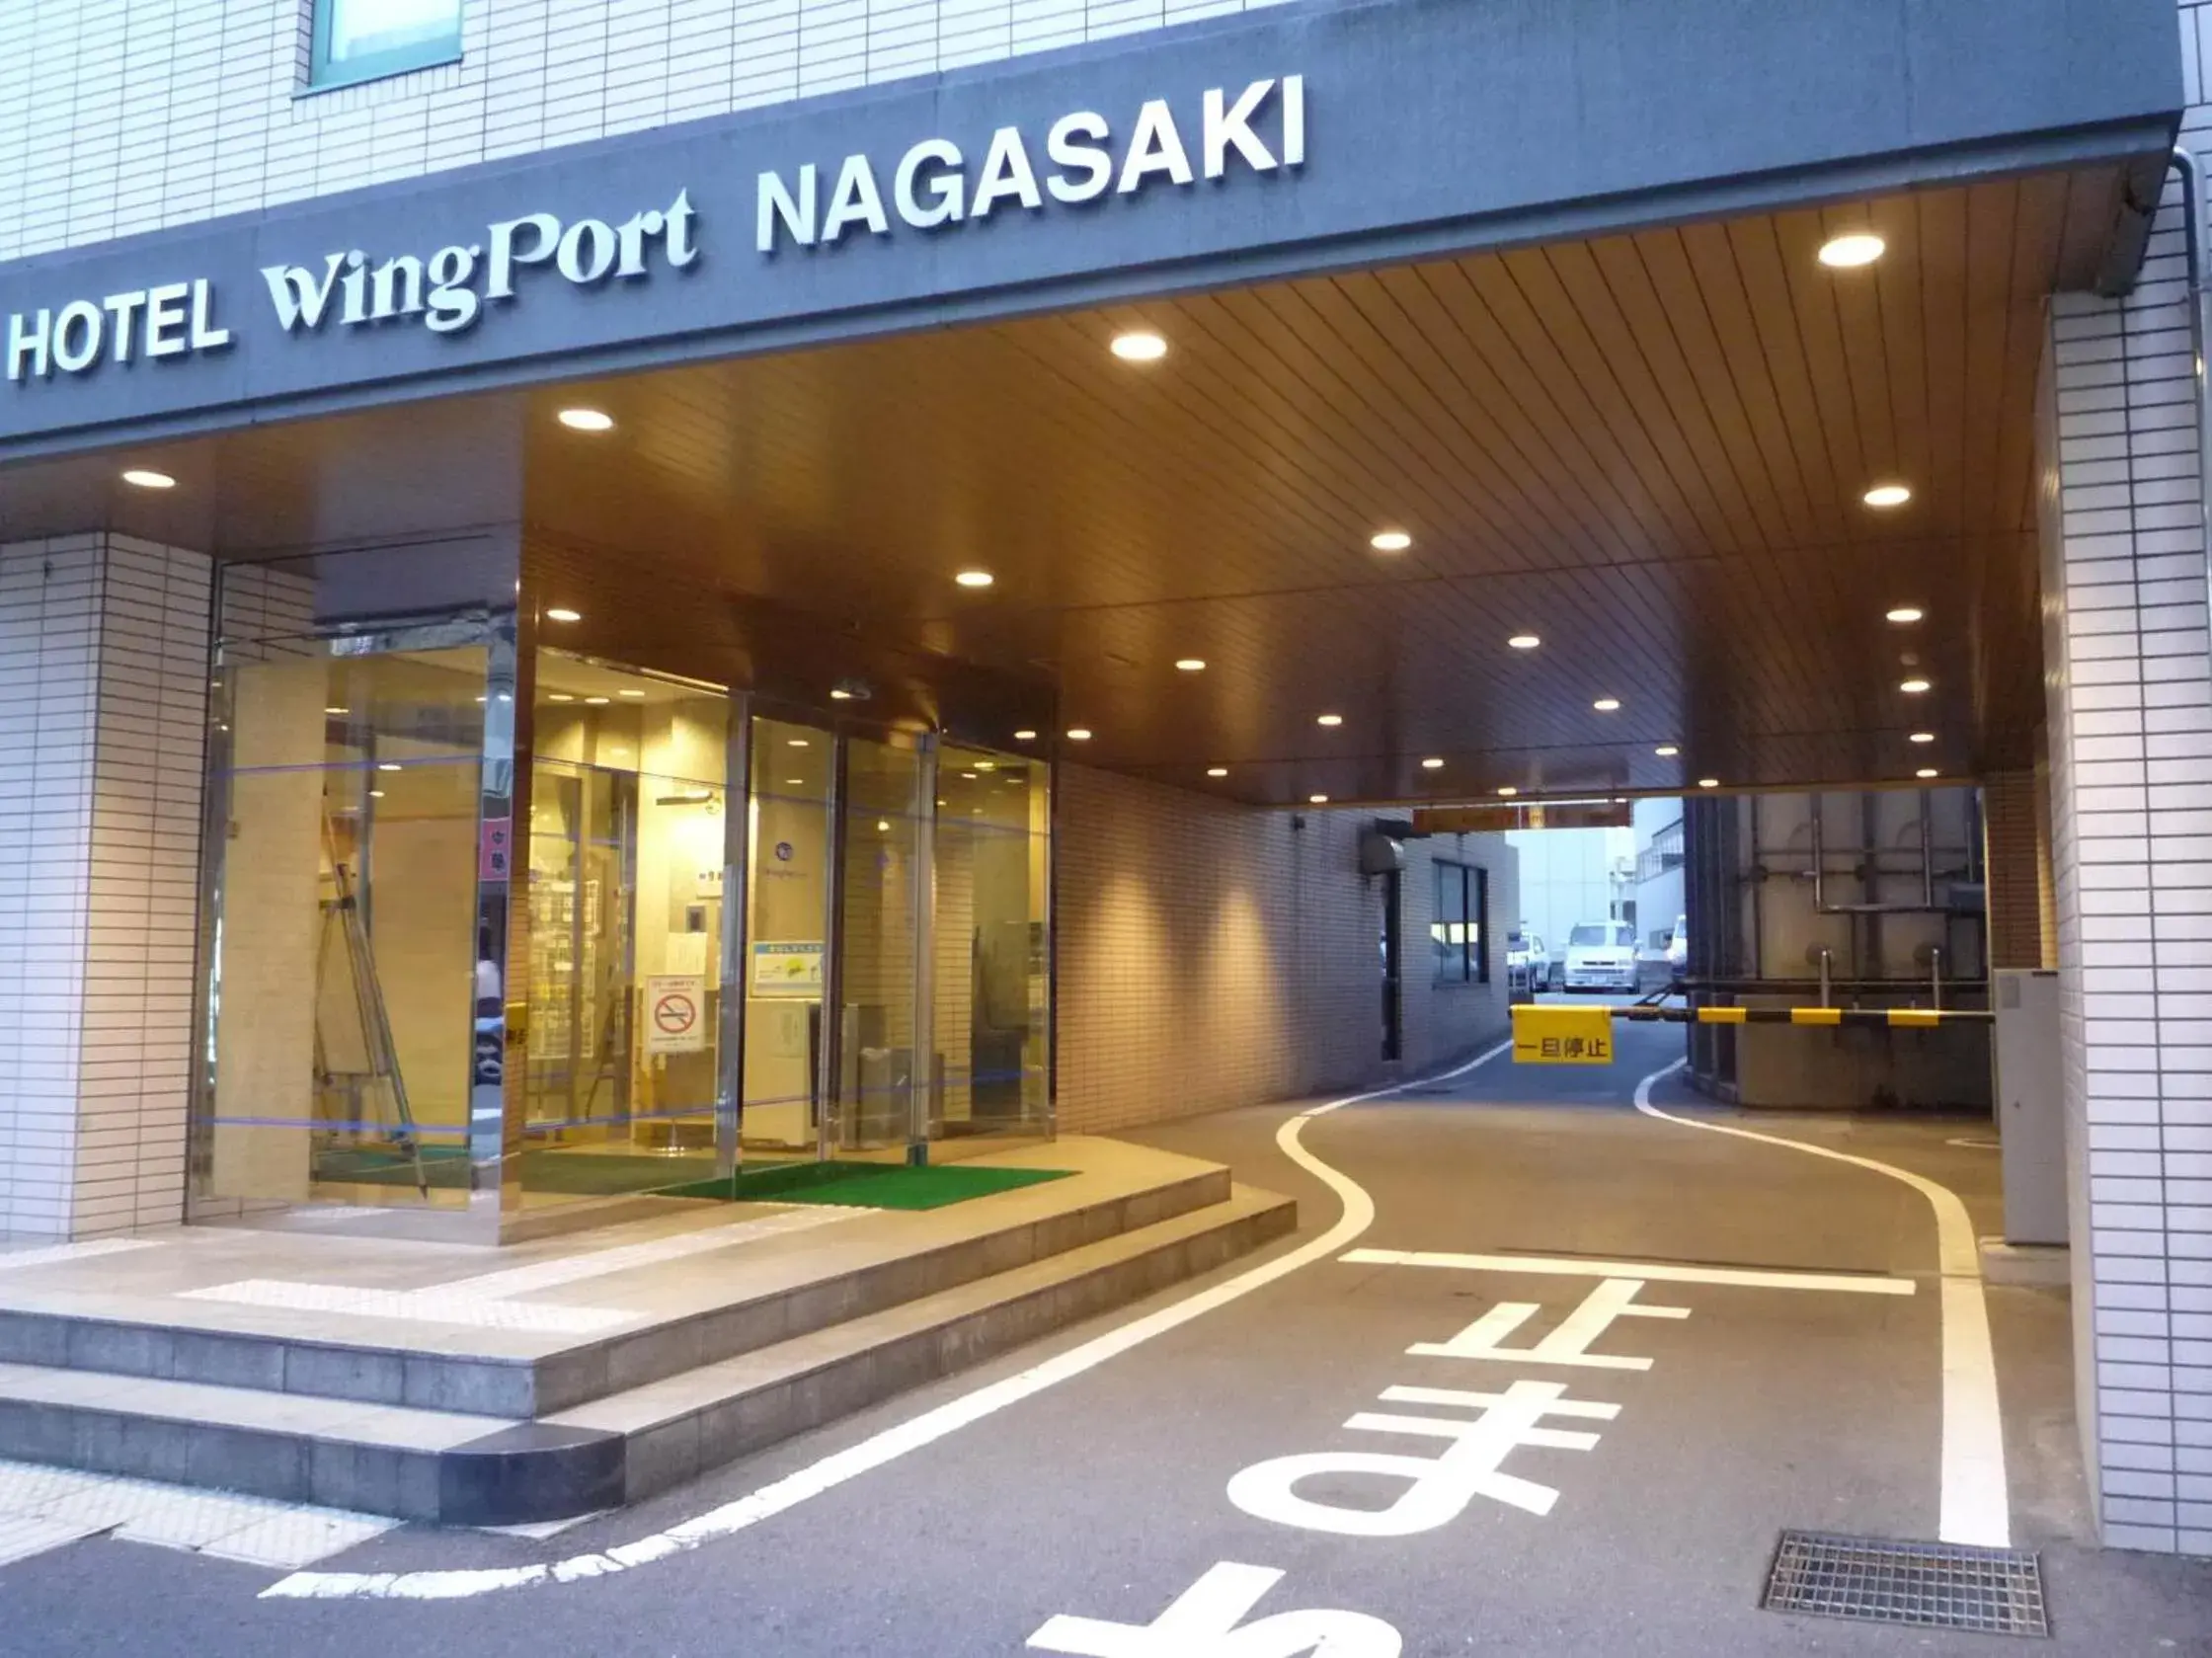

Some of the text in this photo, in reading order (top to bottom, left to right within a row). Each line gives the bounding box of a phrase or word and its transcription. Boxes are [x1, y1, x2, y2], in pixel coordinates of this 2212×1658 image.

[7, 74, 1304, 381] HOTEL WingPort NAGASAKI
[1517, 1037, 1609, 1059] 一旦停止
